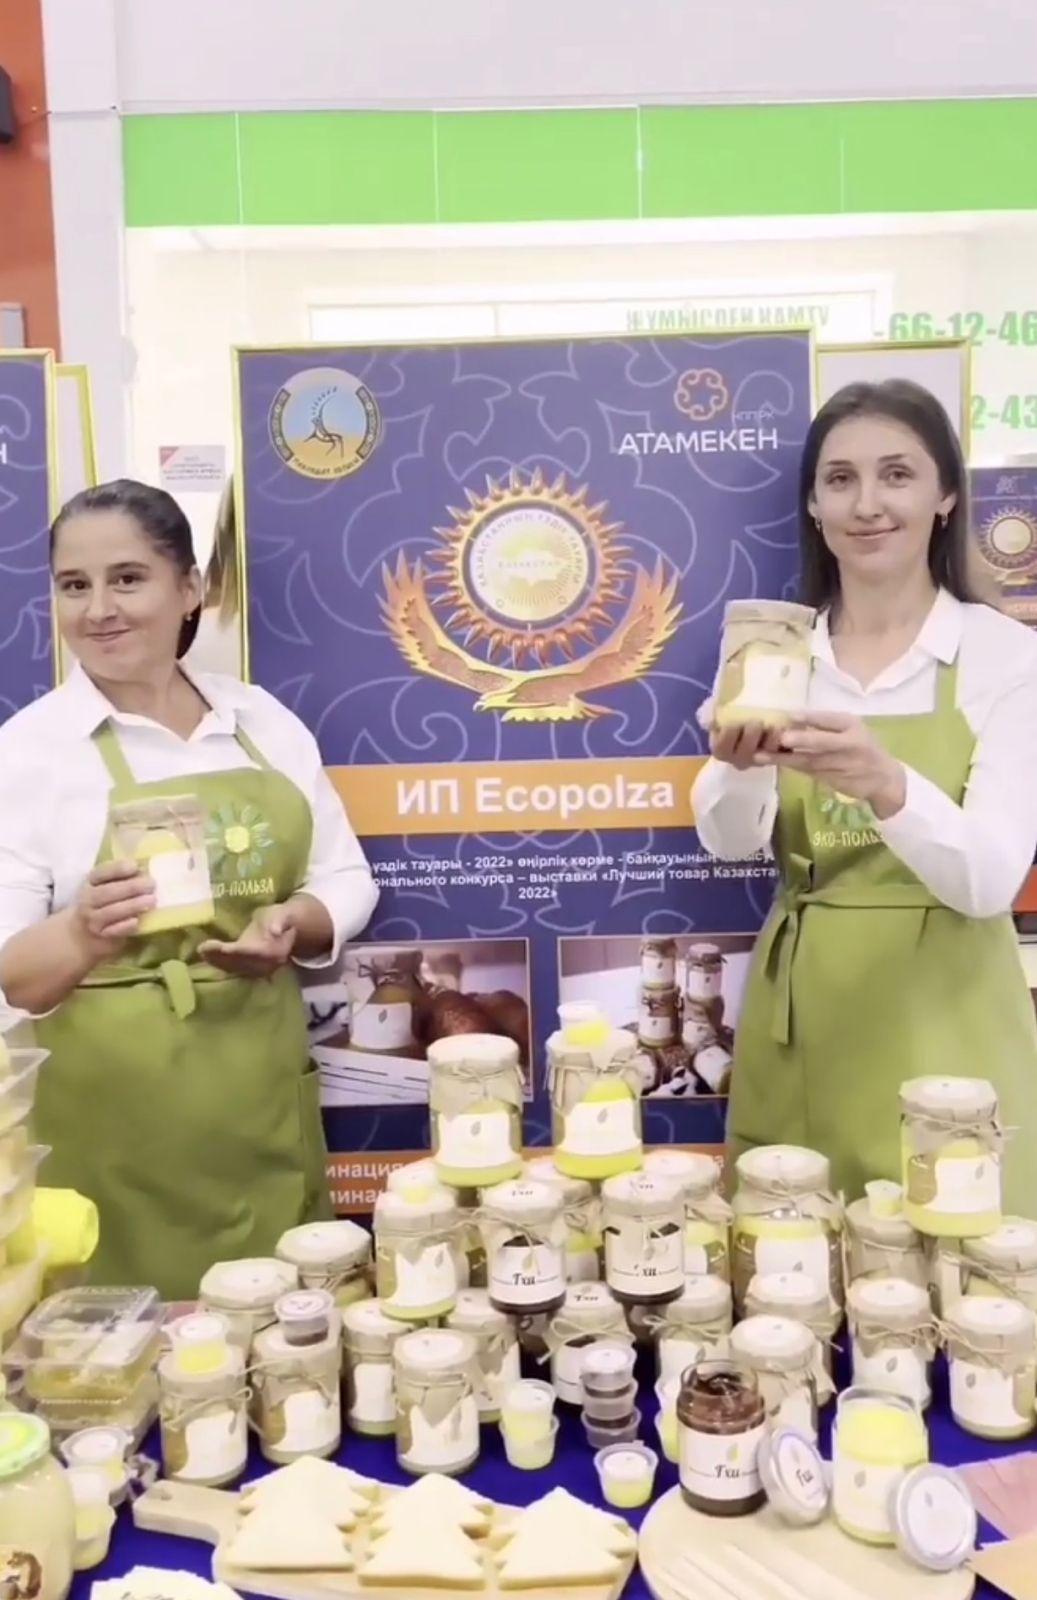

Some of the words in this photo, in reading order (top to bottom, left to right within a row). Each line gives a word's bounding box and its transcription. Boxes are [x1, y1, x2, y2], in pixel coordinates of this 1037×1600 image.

[617, 427, 778, 455] АТАМЕКЕН
[397, 778, 460, 815] ИП
[475, 776, 675, 819] Ecopolza
[411, 857, 462, 872] тауары
[474, 856, 513, 868] 2022»
[373, 872, 447, 887] онального
[450, 871, 514, 887] конкурса
[529, 870, 597, 883] выставки
[602, 867, 665, 883] «Лучший
[669, 868, 709, 881] товар
[713, 866, 779, 879] Казахста
[213, 877, 274, 898] О-ПОЛЬЗА
[518, 887, 558, 899] 2022»
